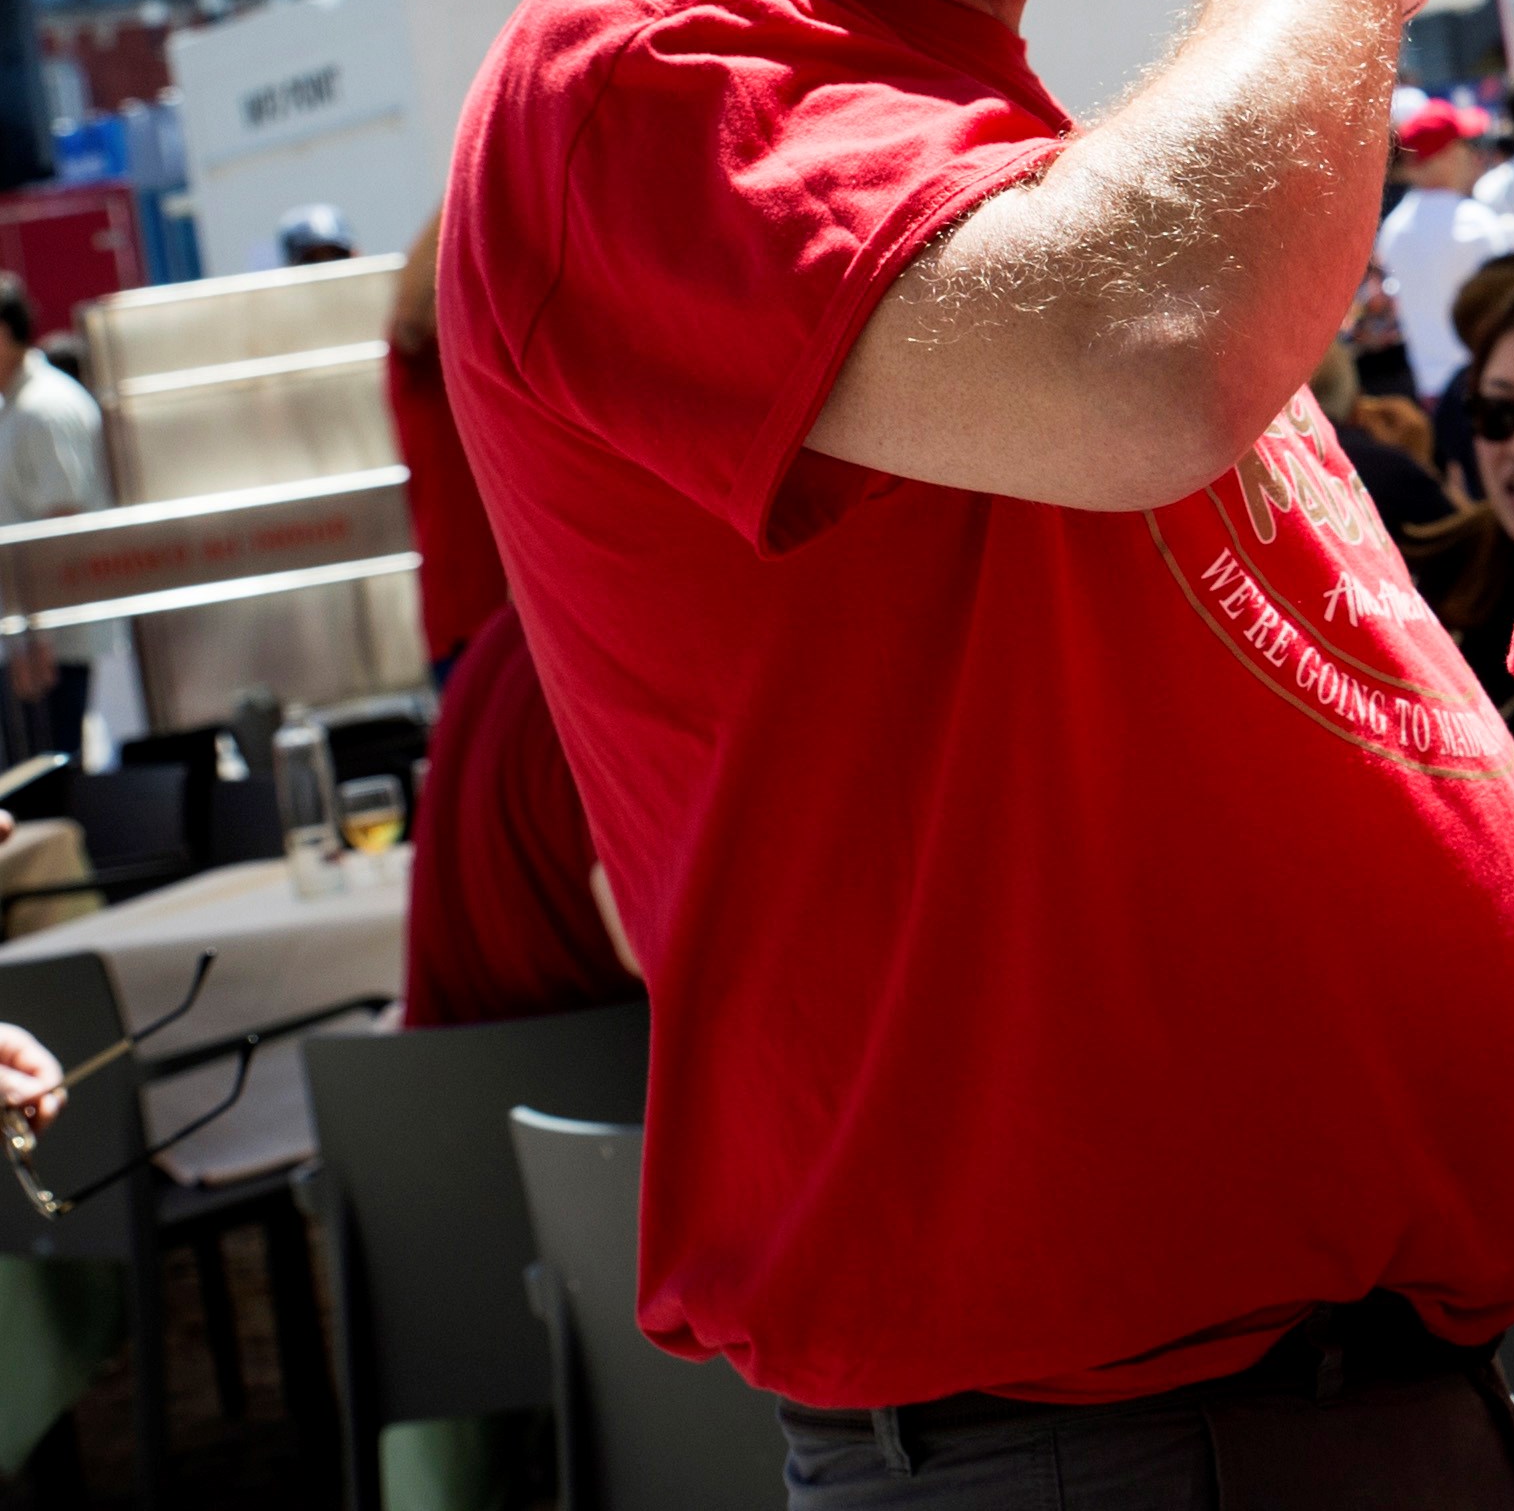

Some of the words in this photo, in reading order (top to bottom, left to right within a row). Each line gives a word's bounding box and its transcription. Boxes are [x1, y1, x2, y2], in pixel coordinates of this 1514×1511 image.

[1201, 546, 1299, 668] WE'RE
[1296, 646, 1388, 735] GOING
[1395, 696, 1431, 753] TO
